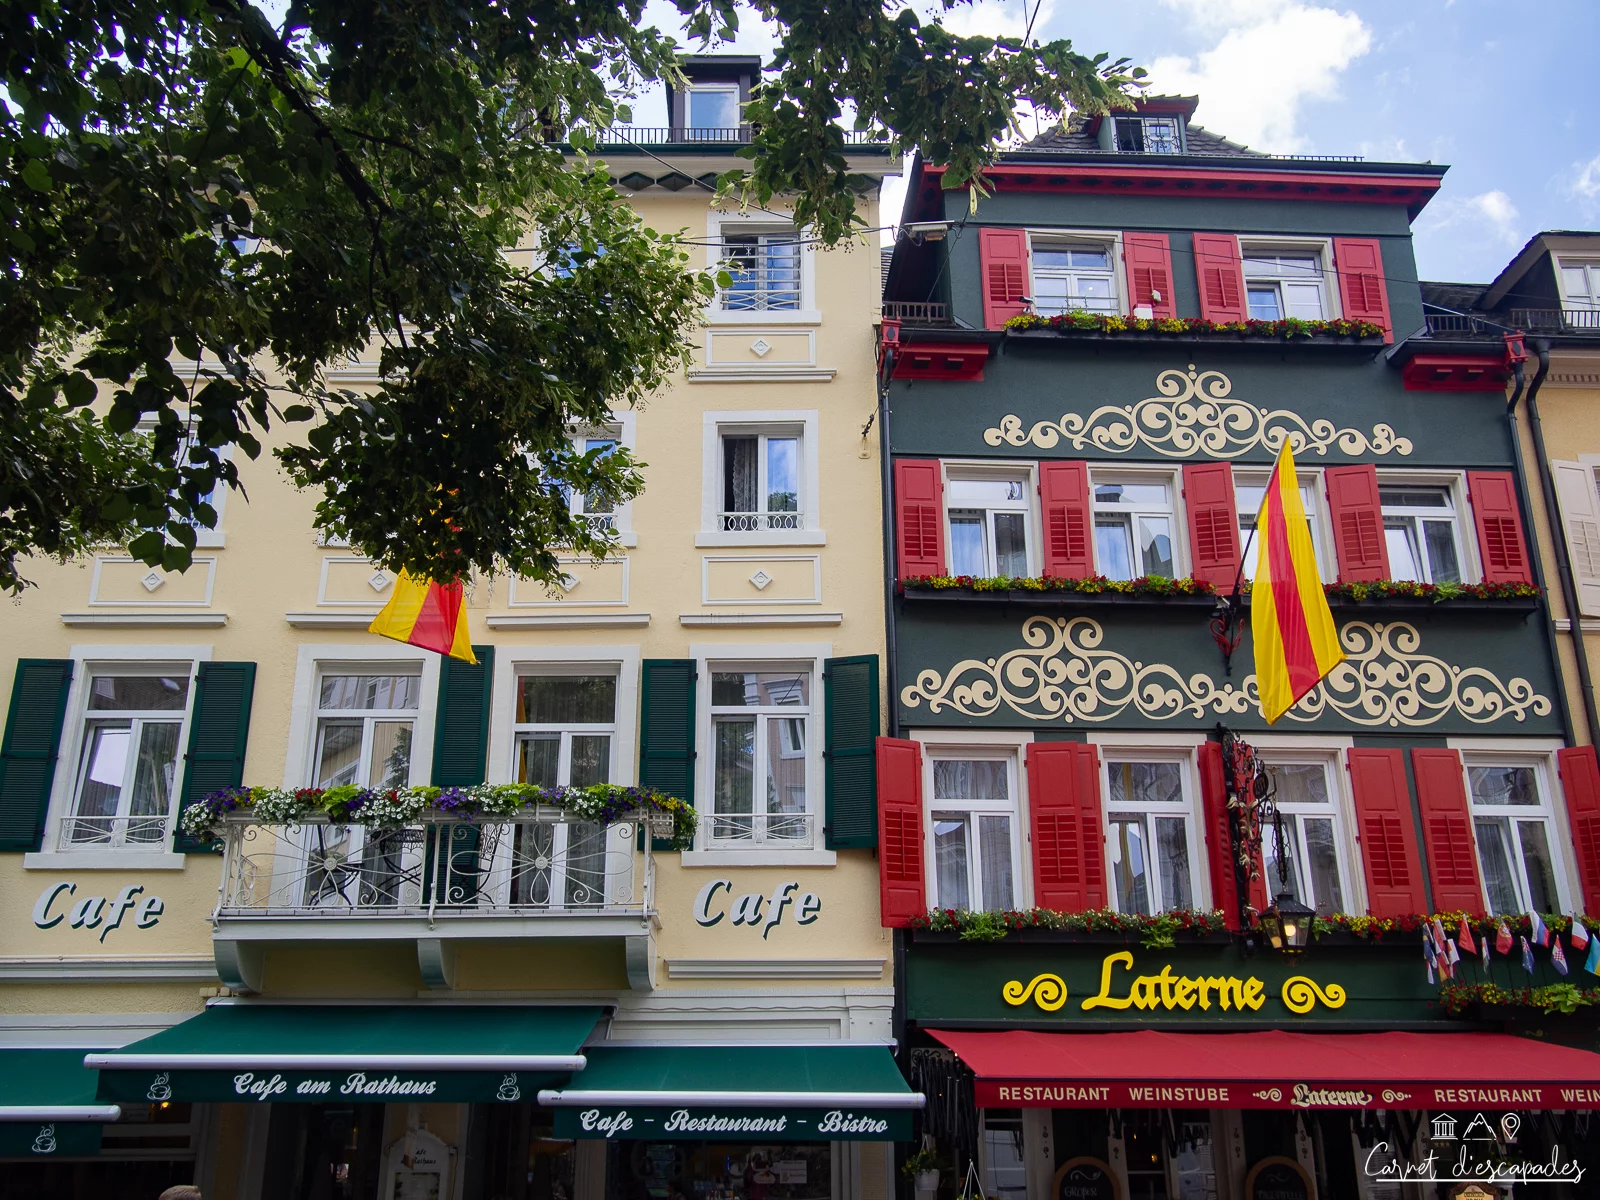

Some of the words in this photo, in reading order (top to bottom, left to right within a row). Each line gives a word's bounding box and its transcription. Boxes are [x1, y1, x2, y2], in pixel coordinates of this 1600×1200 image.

[32, 881, 165, 944] Cafe
[692, 878, 822, 941] Cafe
[1081, 951, 1266, 1011] Laterne
[234, 1072, 288, 1101] Cafe
[296, 1079, 331, 1094] am
[340, 1071, 437, 1095] Rathaus
[999, 1086, 1110, 1101] RESTAURANT
[1128, 1087, 1230, 1102] WEINSTUBE
[1290, 1083, 1373, 1107] Laterne
[1434, 1088, 1542, 1103] RESTAURANT
[580, 1109, 633, 1138] Cafe
[664, 1109, 787, 1132] Restaurant
[818, 1110, 888, 1133] Bistro
